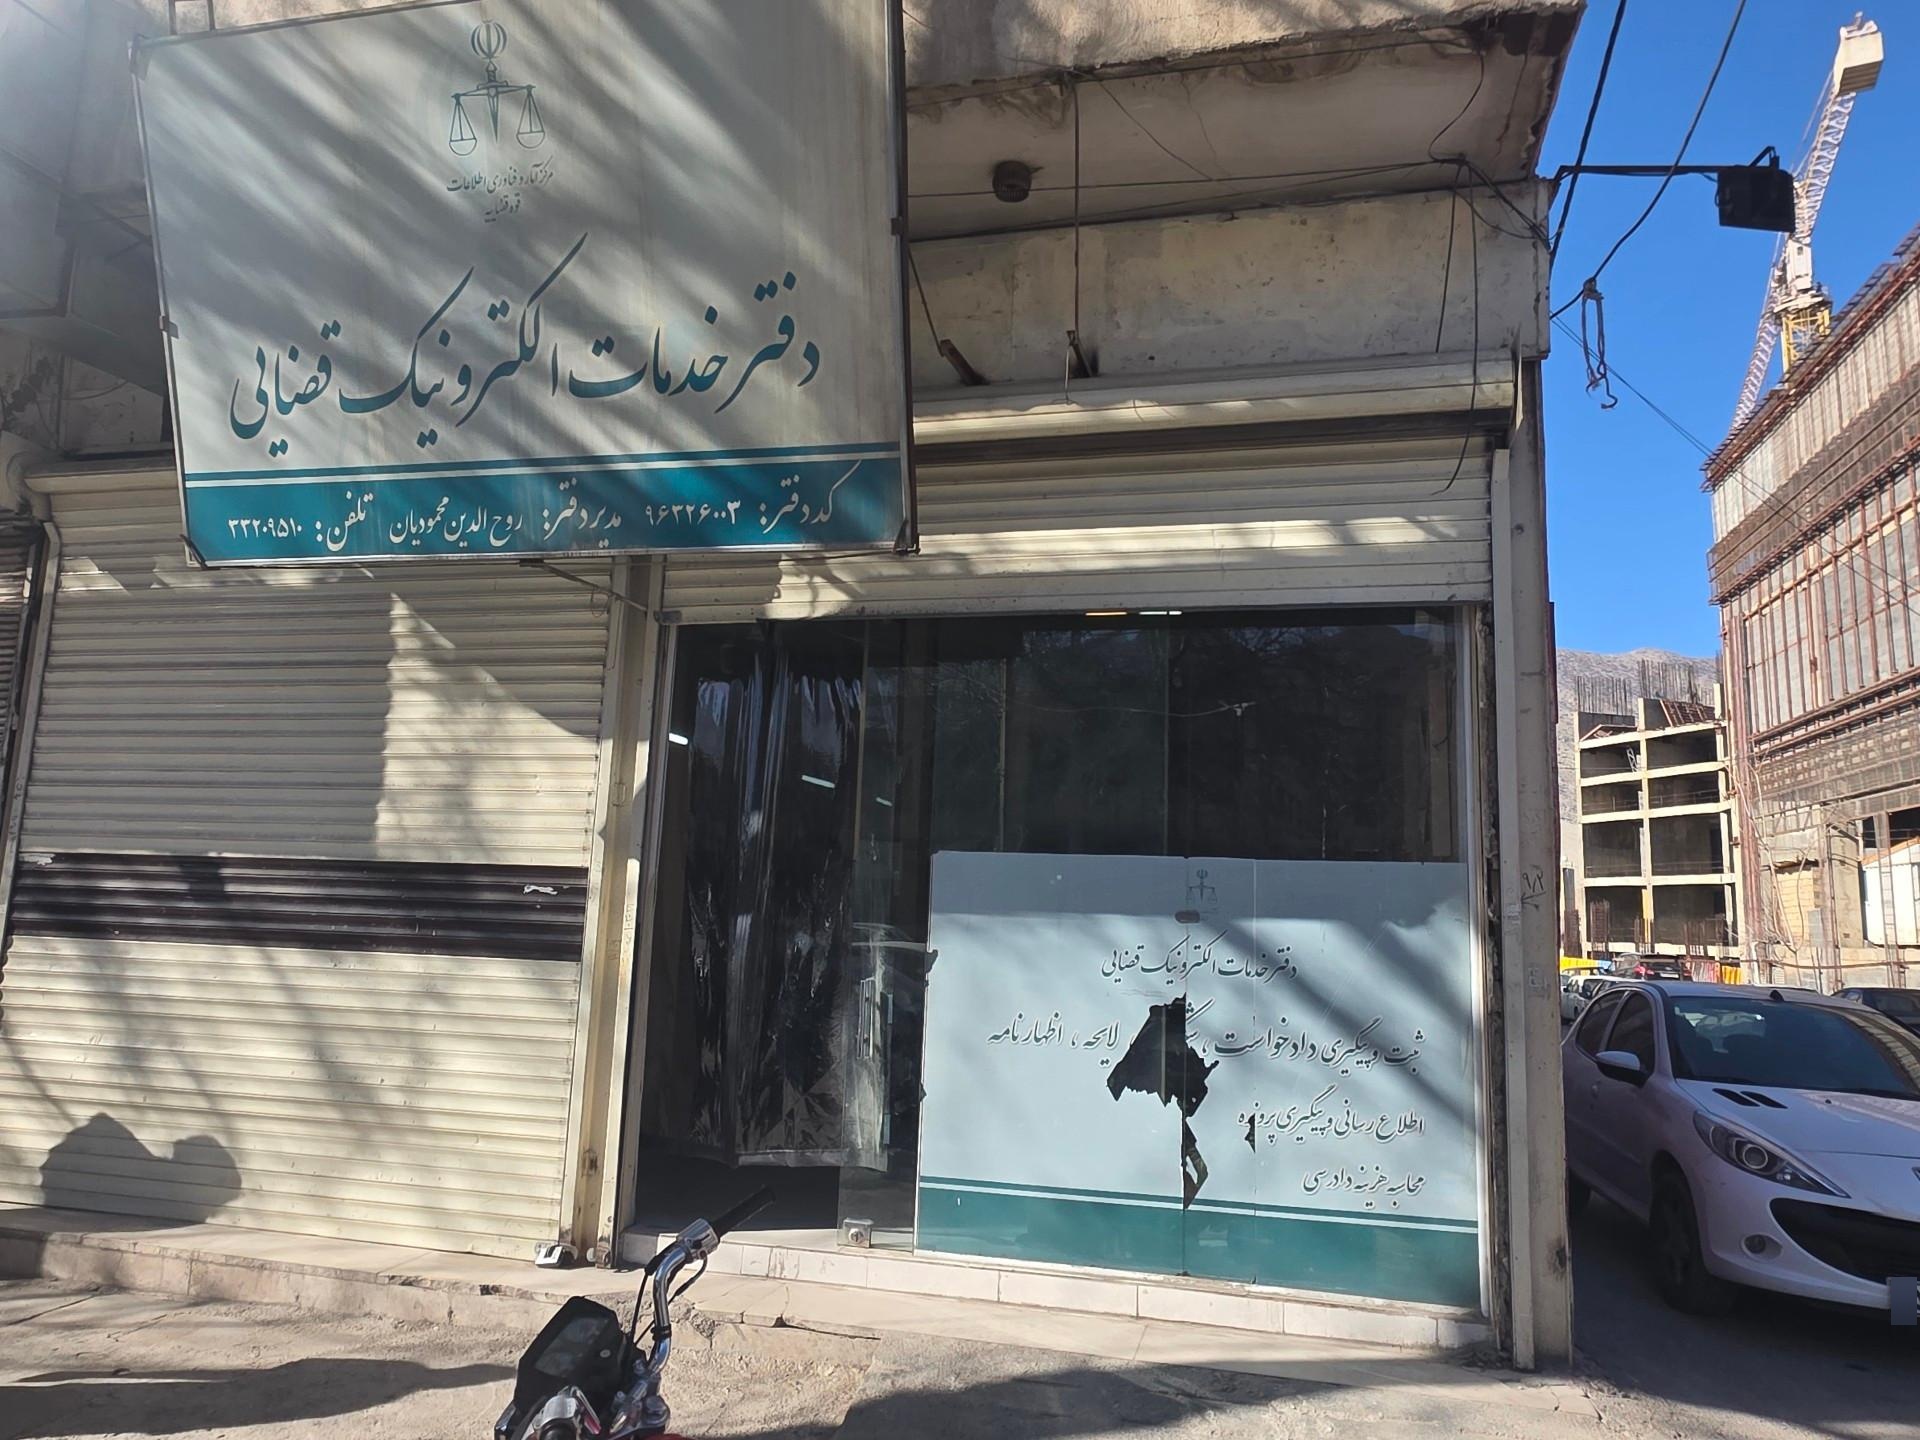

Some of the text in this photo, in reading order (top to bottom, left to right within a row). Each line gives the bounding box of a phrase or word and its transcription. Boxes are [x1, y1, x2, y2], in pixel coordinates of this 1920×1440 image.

[446, 171, 487, 193] اطلاعات
[487, 166, 518, 194] فناوری
[338, 232, 588, 449] الکترونیک
[569, 305, 729, 399] خدمات
[715, 270, 821, 414] دفتر
[810, 459, 862, 524] کد
[228, 517, 303, 540] ۳۳۲۰۹۵۱۰
[389, 496, 450, 547] محمودیان
[443, 507, 488, 548] الدین
[489, 512, 523, 547] روح
[589, 505, 622, 549] مدیر
[645, 499, 741, 526] ۹۶۳۲۶۰۰۳
[1140, 929, 1228, 985] الکترونیک
[1217, 953, 1268, 979] خدمات
[1263, 946, 1298, 983] دفتر
[1383, 1030, 1424, 1073] ثبت
[1334, 1099, 1375, 1137] رسانی
[1375, 1112, 1425, 1141] اطلاع
[1303, 1165, 1426, 1207] محاسبه هزینه دادرسی
